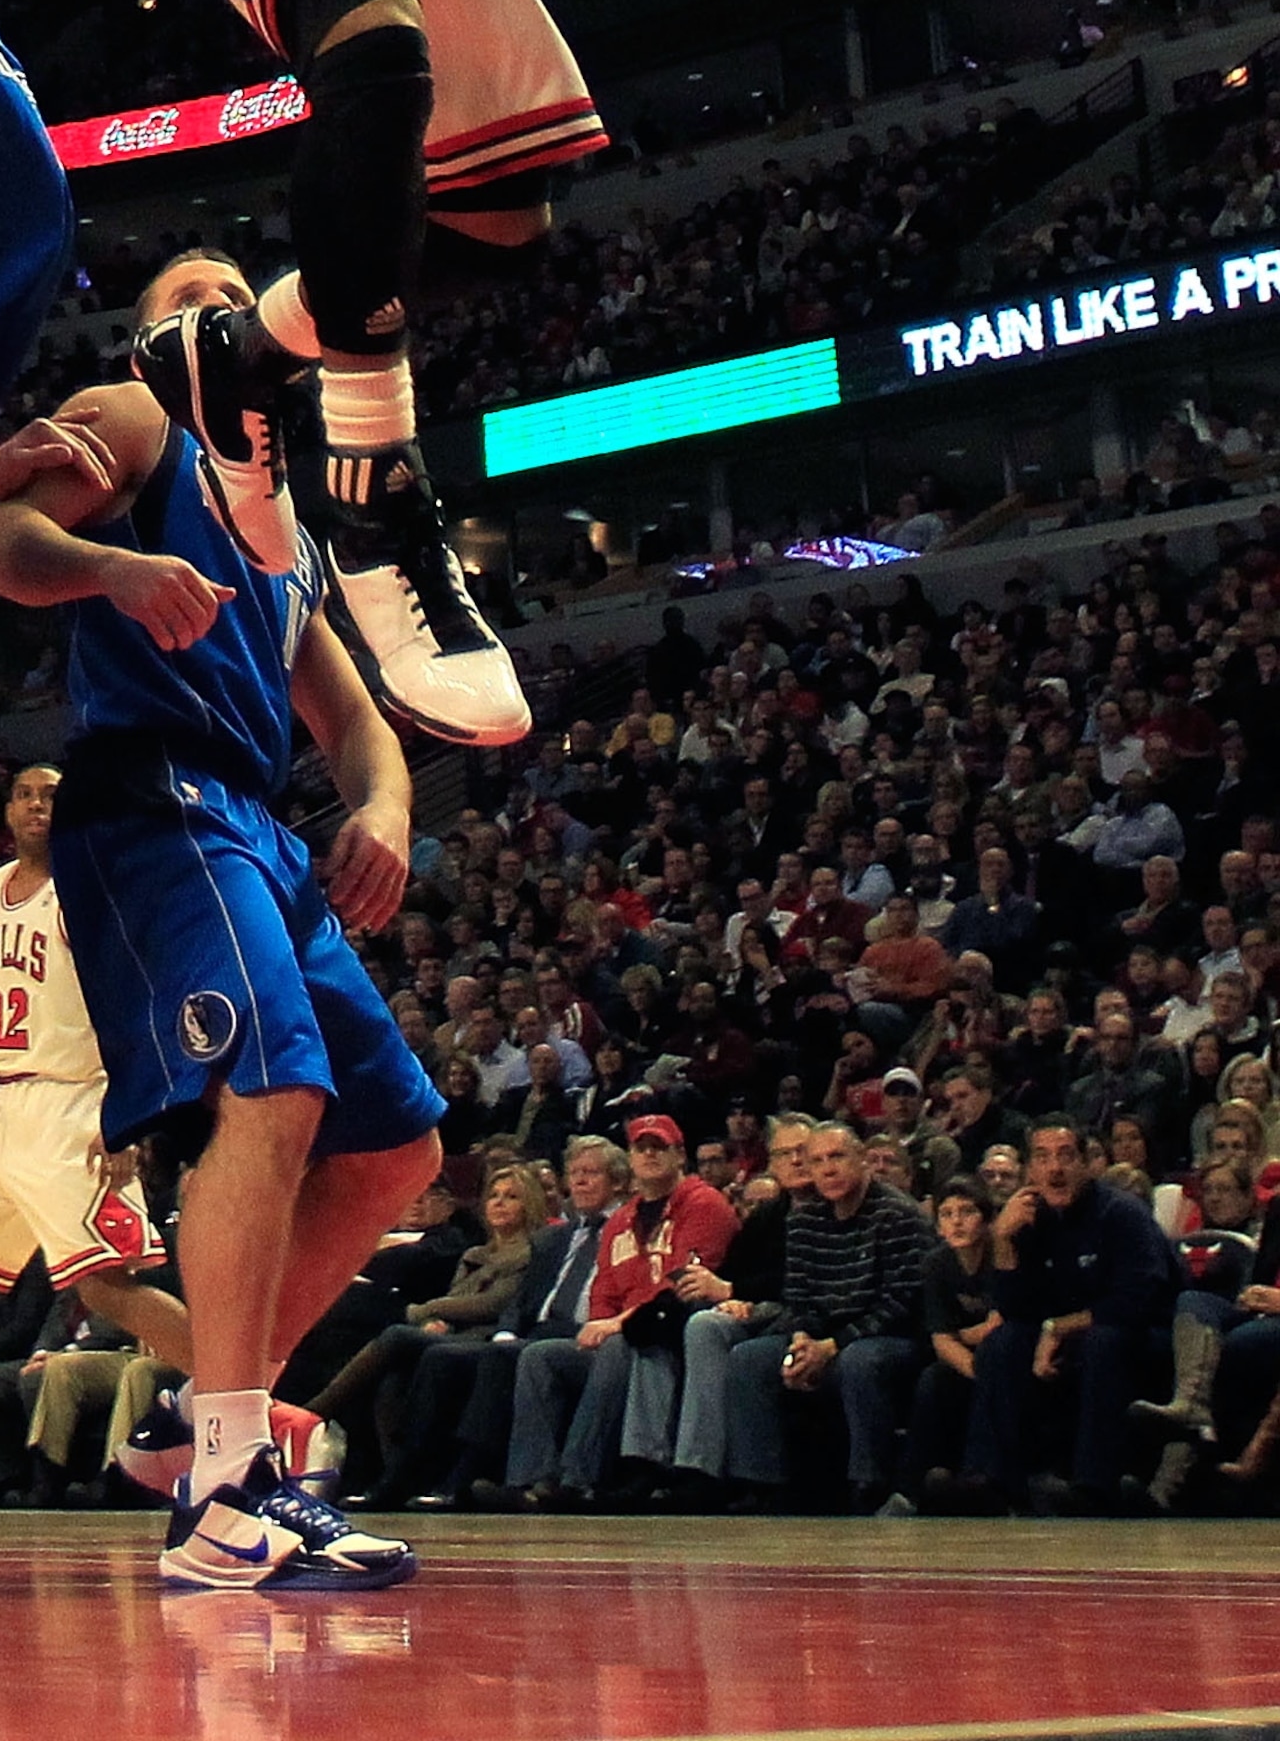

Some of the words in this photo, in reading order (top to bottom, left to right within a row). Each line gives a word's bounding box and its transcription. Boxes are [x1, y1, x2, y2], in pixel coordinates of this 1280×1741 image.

[902, 303, 1045, 377] TRAIN
[1051, 277, 1159, 346] LIKE
[1170, 268, 1215, 322] A
